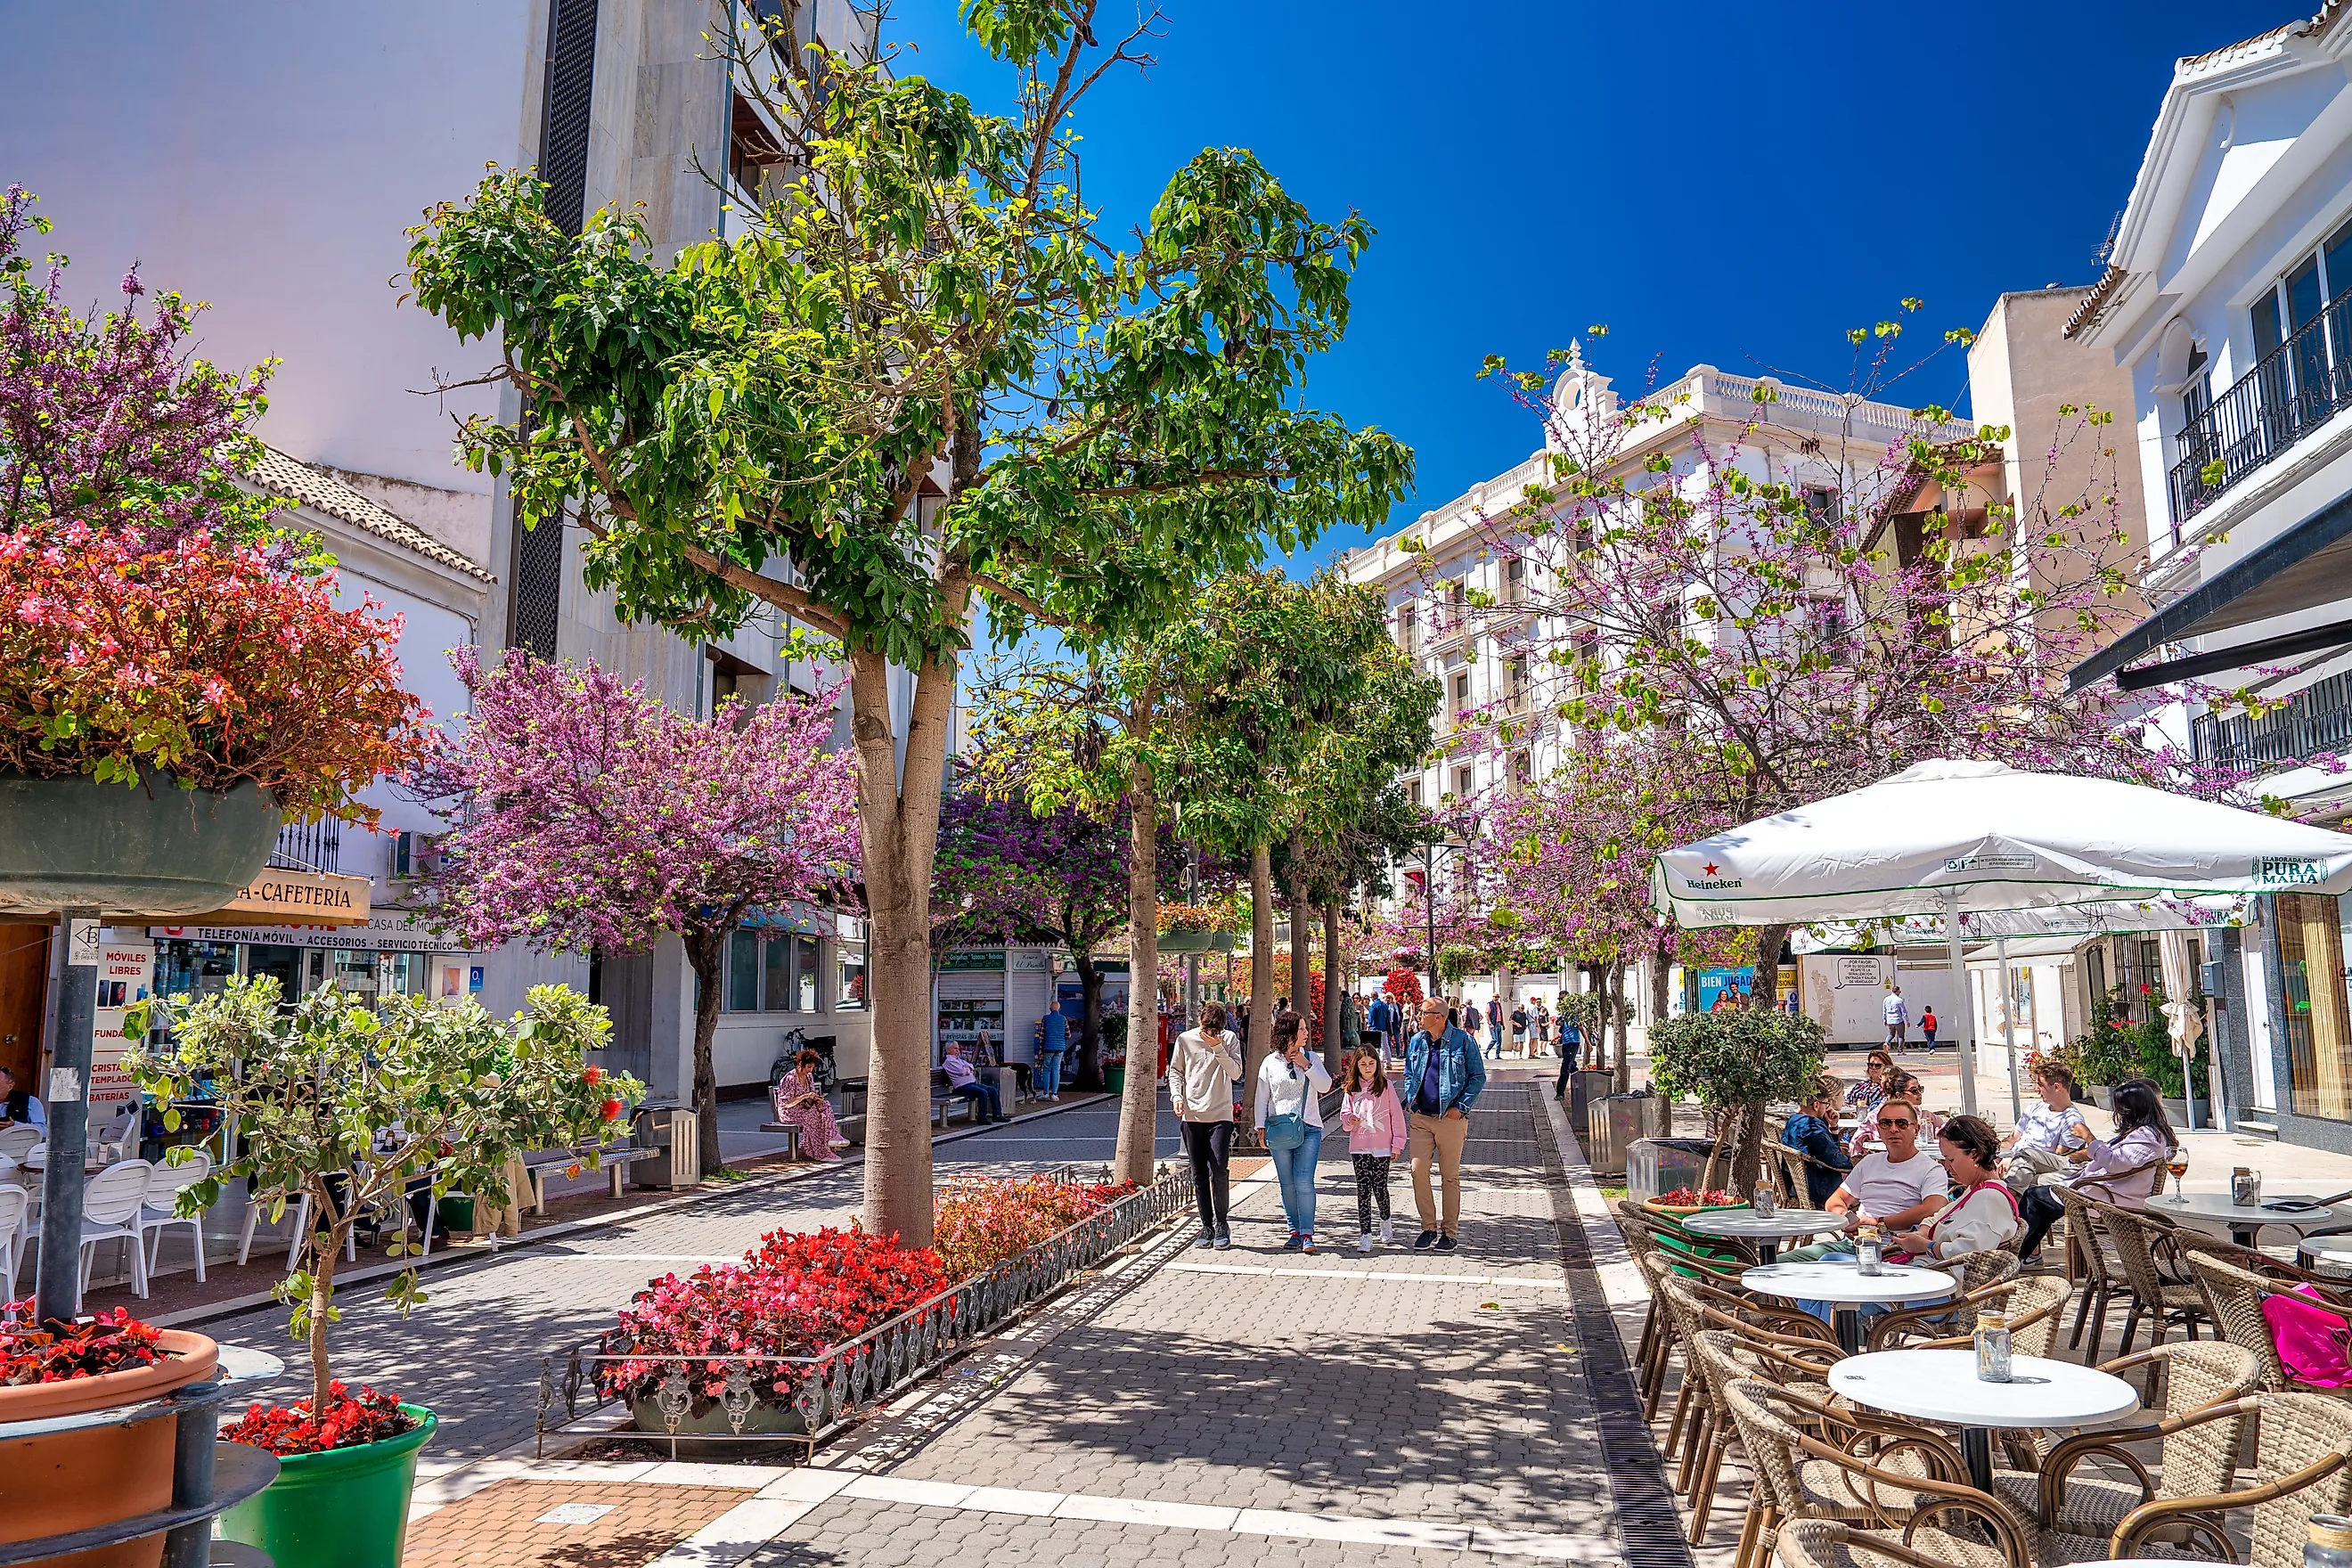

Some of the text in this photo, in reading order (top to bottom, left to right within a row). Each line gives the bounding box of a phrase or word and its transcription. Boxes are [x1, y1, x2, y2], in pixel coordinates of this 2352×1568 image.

[2262, 862, 2317, 875] PURA
[1686, 878, 1743, 890] Heineken
[2262, 874, 2318, 884] MALTA
[2209, 911, 2230, 919] URA
[368, 919, 393, 930] CASA
[396, 919, 413, 932] DEL
[197, 928, 453, 951] TELEFONÍA MÓVIL ACCESORIOS SERVICIO TÉCNICO
[106, 951, 146, 963] MÓVILES
[109, 966, 142, 976] LIBRES
[1702, 975, 1752, 988] BIEN JUGAD
[94, 1030, 124, 1038] FUNDA
[89, 1092, 130, 1102] BATERÍAS
